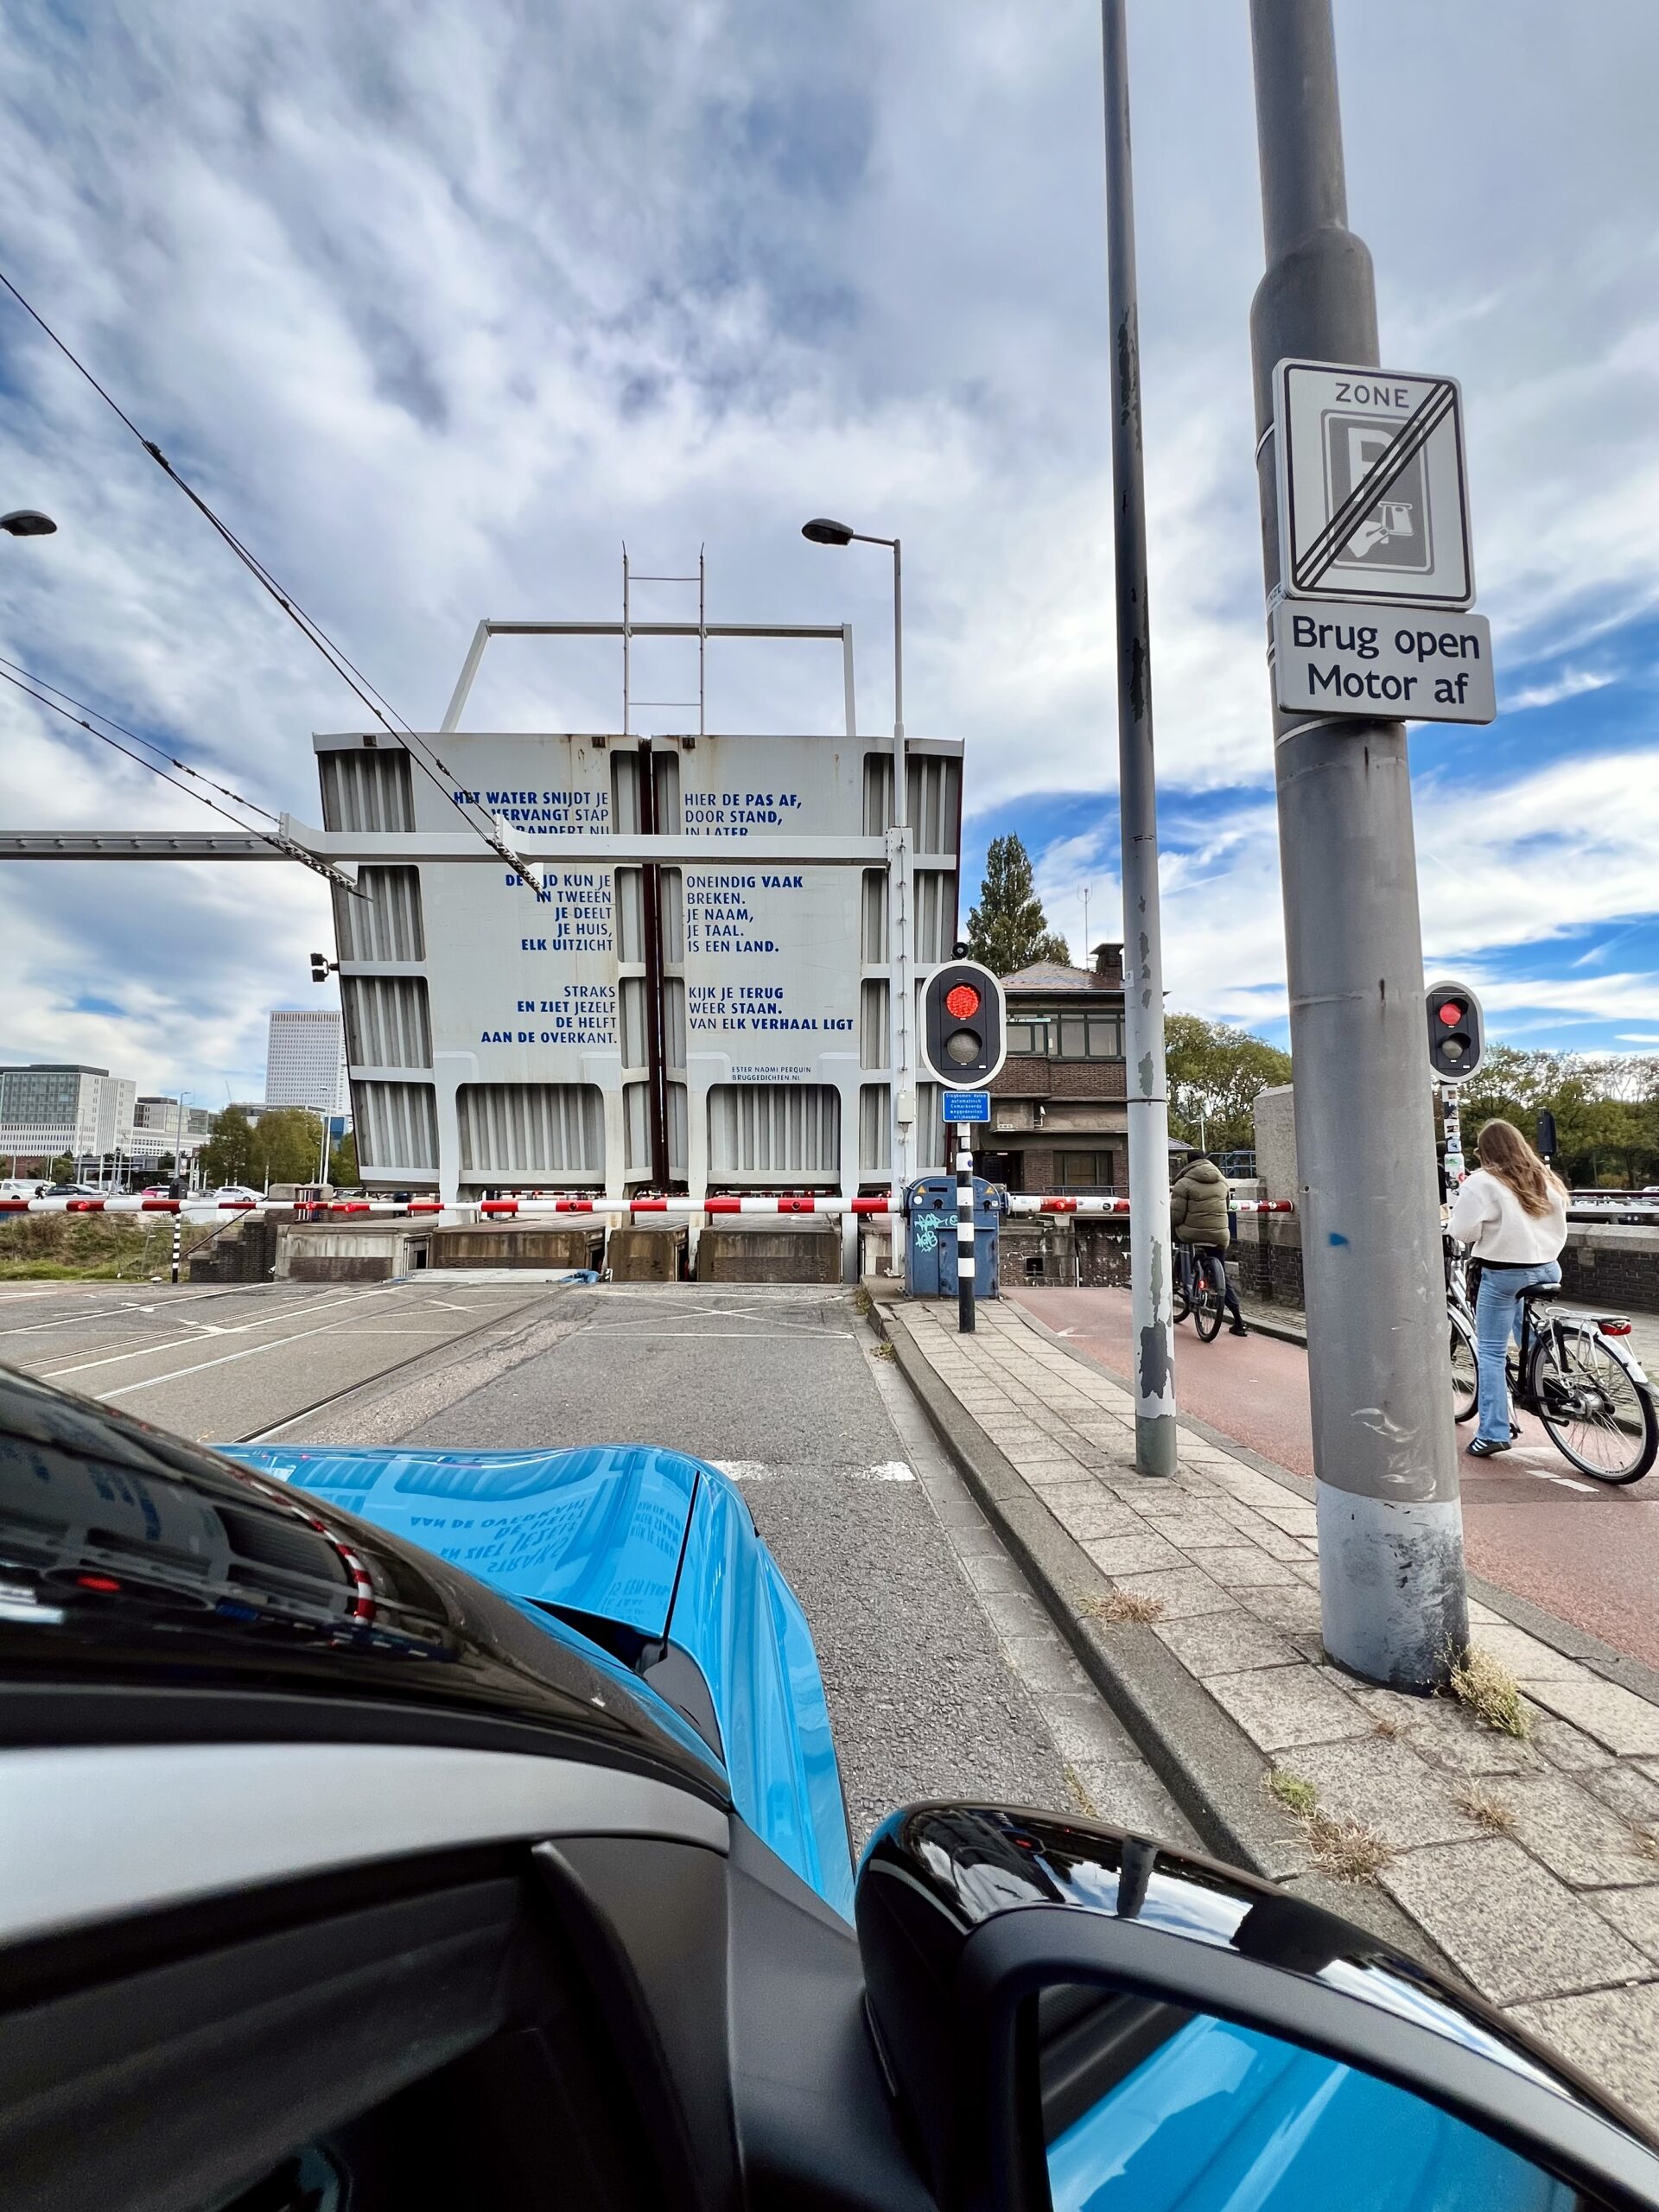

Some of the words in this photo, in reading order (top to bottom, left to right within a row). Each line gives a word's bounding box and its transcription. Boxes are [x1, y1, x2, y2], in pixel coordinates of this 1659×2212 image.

[1335, 382, 1410, 409] ZONE
[1293, 614, 1380, 660] Brug
[1395, 628, 1480, 663] open
[1307, 663, 1417, 701] Motor
[1434, 672, 1469, 704] af
[486, 791, 537, 804] WATER
[543, 791, 590, 808] SNIJDT
[595, 792, 609, 808] JE
[684, 793, 716, 806] HIER
[722, 794, 740, 806] DE
[746, 794, 773, 806] PAS
[779, 794, 802, 809] AF,
[575, 809, 609, 821] STAP
[685, 810, 724, 823] DOOR
[730, 810, 783, 826] STAND,
[505, 874, 524, 887] DE
[563, 874, 594, 887] KUN
[598, 874, 611, 891] JE
[686, 876, 756, 888] ONEINDIG
[761, 876, 803, 887] VAAK
[557, 888, 611, 903] TWEEËN
[687, 893, 746, 905] BREKEN.
[555, 906, 568, 922] JE
[574, 907, 612, 918] DEELT
[687, 909, 699, 923] JE
[704, 909, 753, 923] NAAM,
[557, 924, 570, 938] JE
[576, 924, 613, 938] HUIS,
[687, 925, 699, 939] JE
[705, 925, 744, 937] TAAL.
[521, 939, 547, 950] ELK
[552, 939, 613, 951] UITZICHT
[688, 941, 700, 952] IS
[706, 941, 730, 952] EEN
[736, 941, 779, 952] LAND.
[564, 986, 615, 997] STRAKS
[690, 987, 715, 1001] KIJK
[721, 987, 734, 1001] JE
[740, 987, 784, 999] TERUG
[517, 1001, 535, 1012] EN
[540, 1001, 569, 1013] ZIET
[574, 1001, 616, 1015] JEZELF
[690, 1002, 726, 1014] WEER
[731, 1002, 783, 1014] STAAN.
[556, 1017, 573, 1028] DE
[579, 1017, 617, 1028] HELFT
[690, 1018, 716, 1029] VAN
[722, 1018, 747, 1029] ELK
[751, 1018, 818, 1030] VERHAAL
[823, 1019, 854, 1030] LIGT
[481, 1032, 512, 1043] AAN
[518, 1032, 535, 1043] DE
[540, 1032, 618, 1044] OVERKANT.
